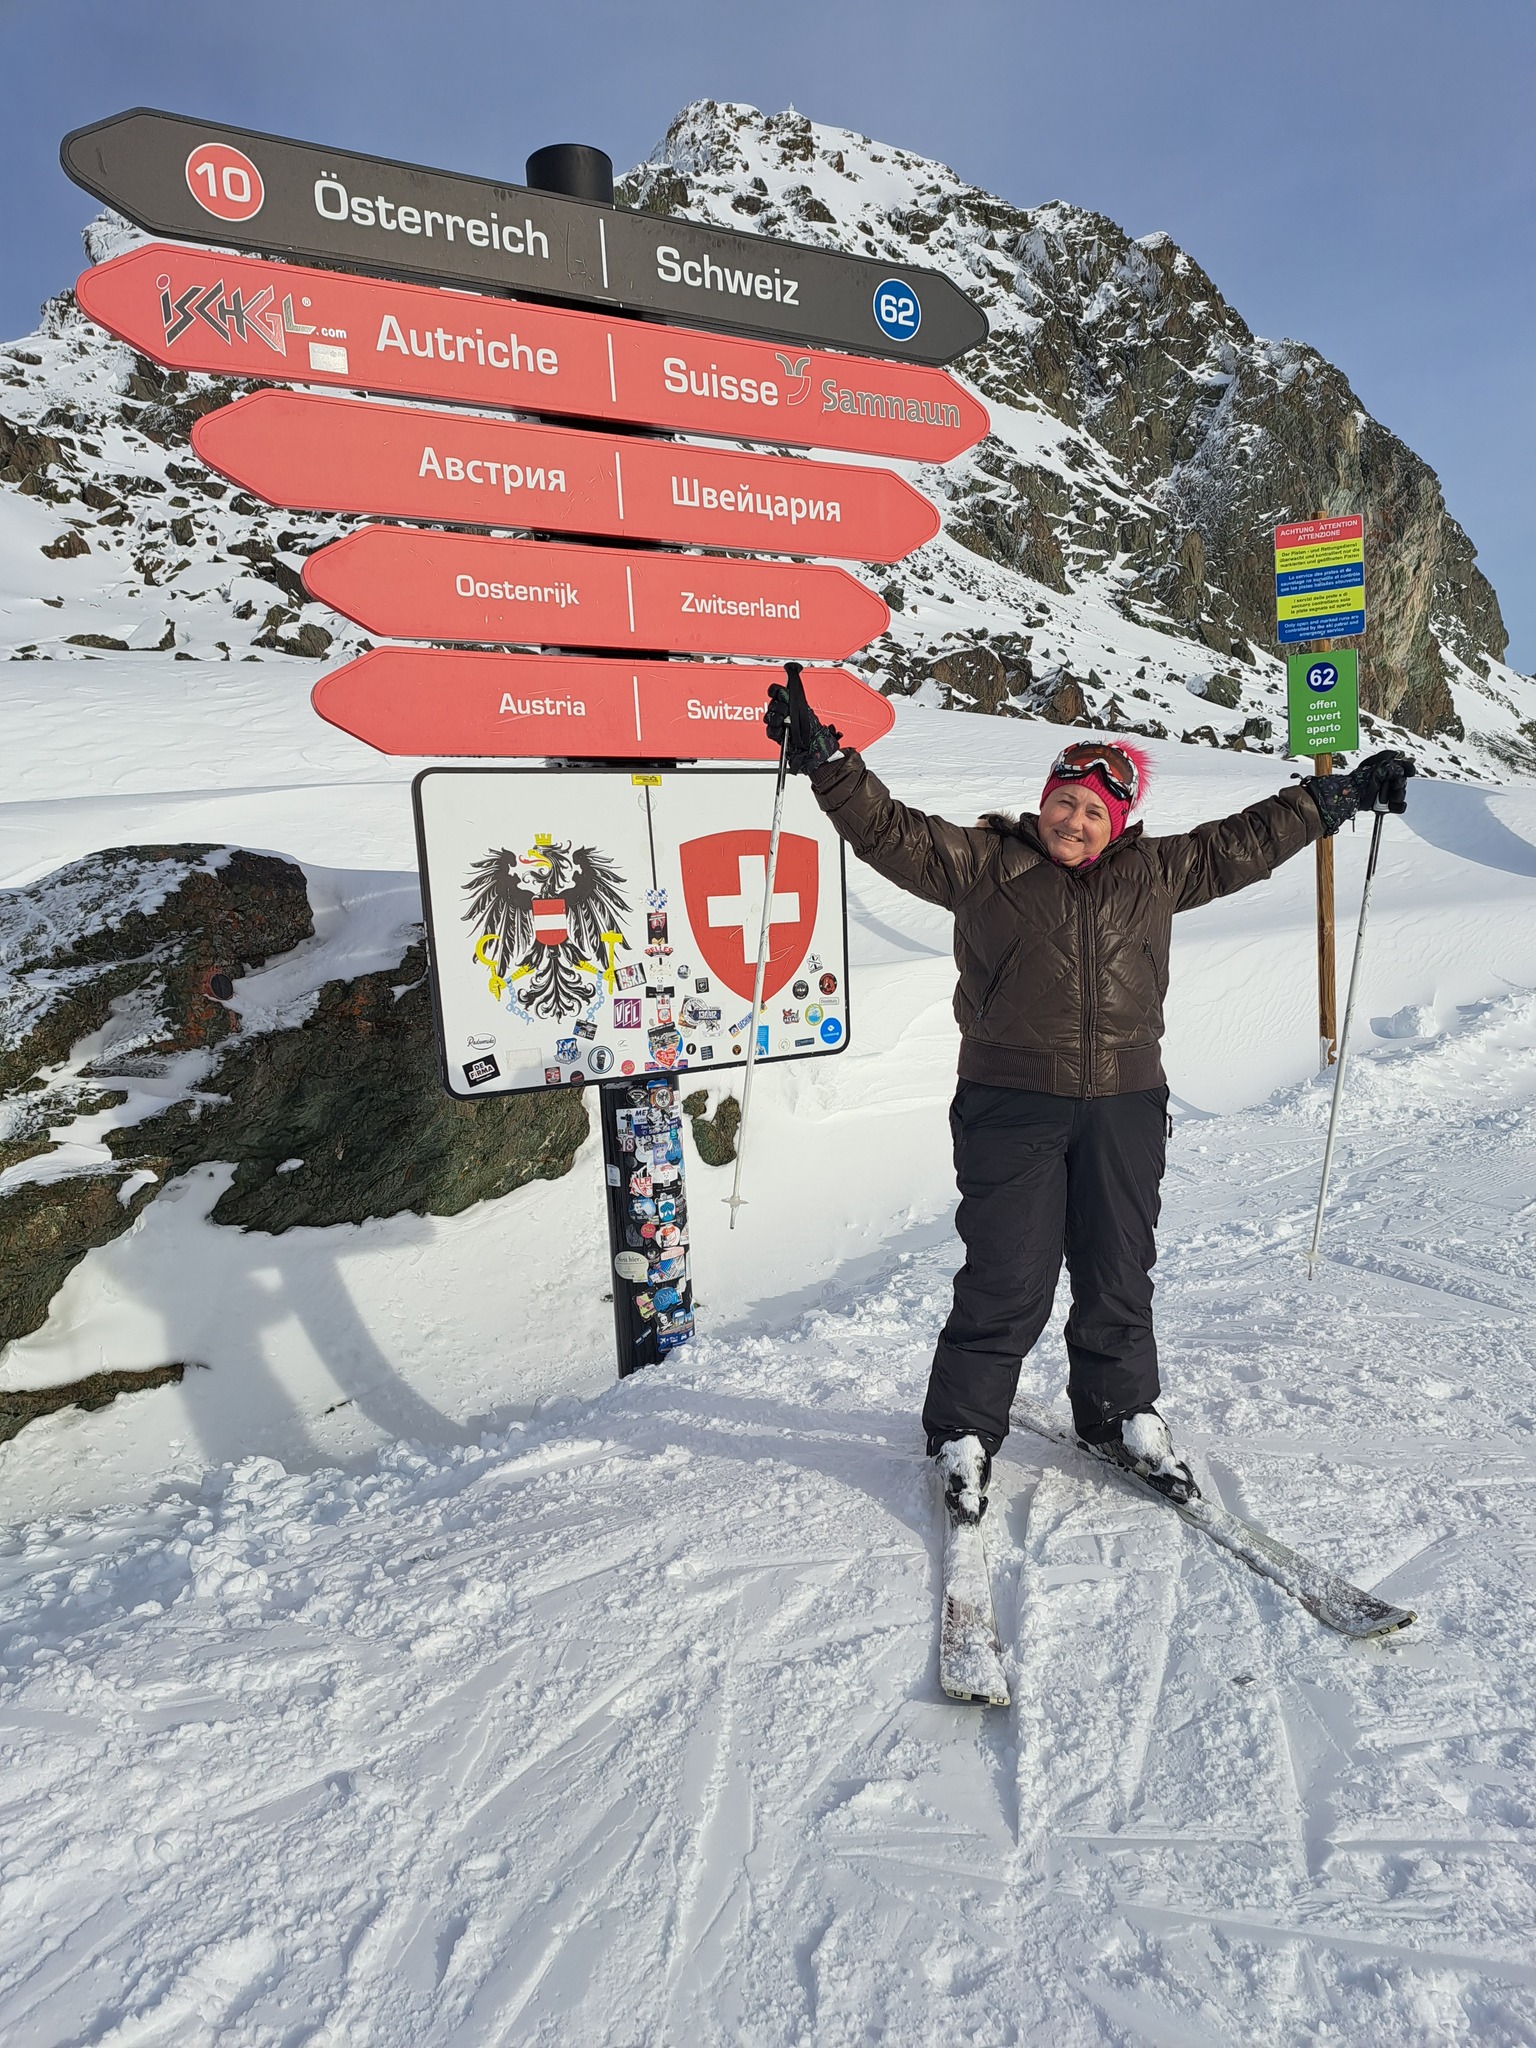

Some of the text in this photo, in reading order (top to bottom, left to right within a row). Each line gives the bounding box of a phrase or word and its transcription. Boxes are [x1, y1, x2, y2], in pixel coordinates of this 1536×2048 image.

[195, 162, 551, 260] 10 Österreich
[656, 245, 915, 327] Schweiz 62
[377, 315, 559, 374] Autriche
[663, 357, 779, 406] Suisse
[821, 379, 961, 429] Samnaun
[418, 446, 566, 495] Австрия
[671, 476, 841, 525] Швейцария
[1280, 520, 1358, 536] ACHTUNG ATTENTION
[1297, 530, 1340, 541] ATTENZIONE
[455, 574, 580, 608] Oostenrijk
[680, 591, 801, 619] Zwitserland
[1309, 668, 1335, 686] 62
[498, 693, 586, 716] Austria
[686, 699, 769, 721] Switzerl
[1306, 711, 1341, 722] ouvert
[1309, 700, 1337, 710] offen
[1306, 723, 1341, 735] aperto
[1308, 736, 1336, 747] open
